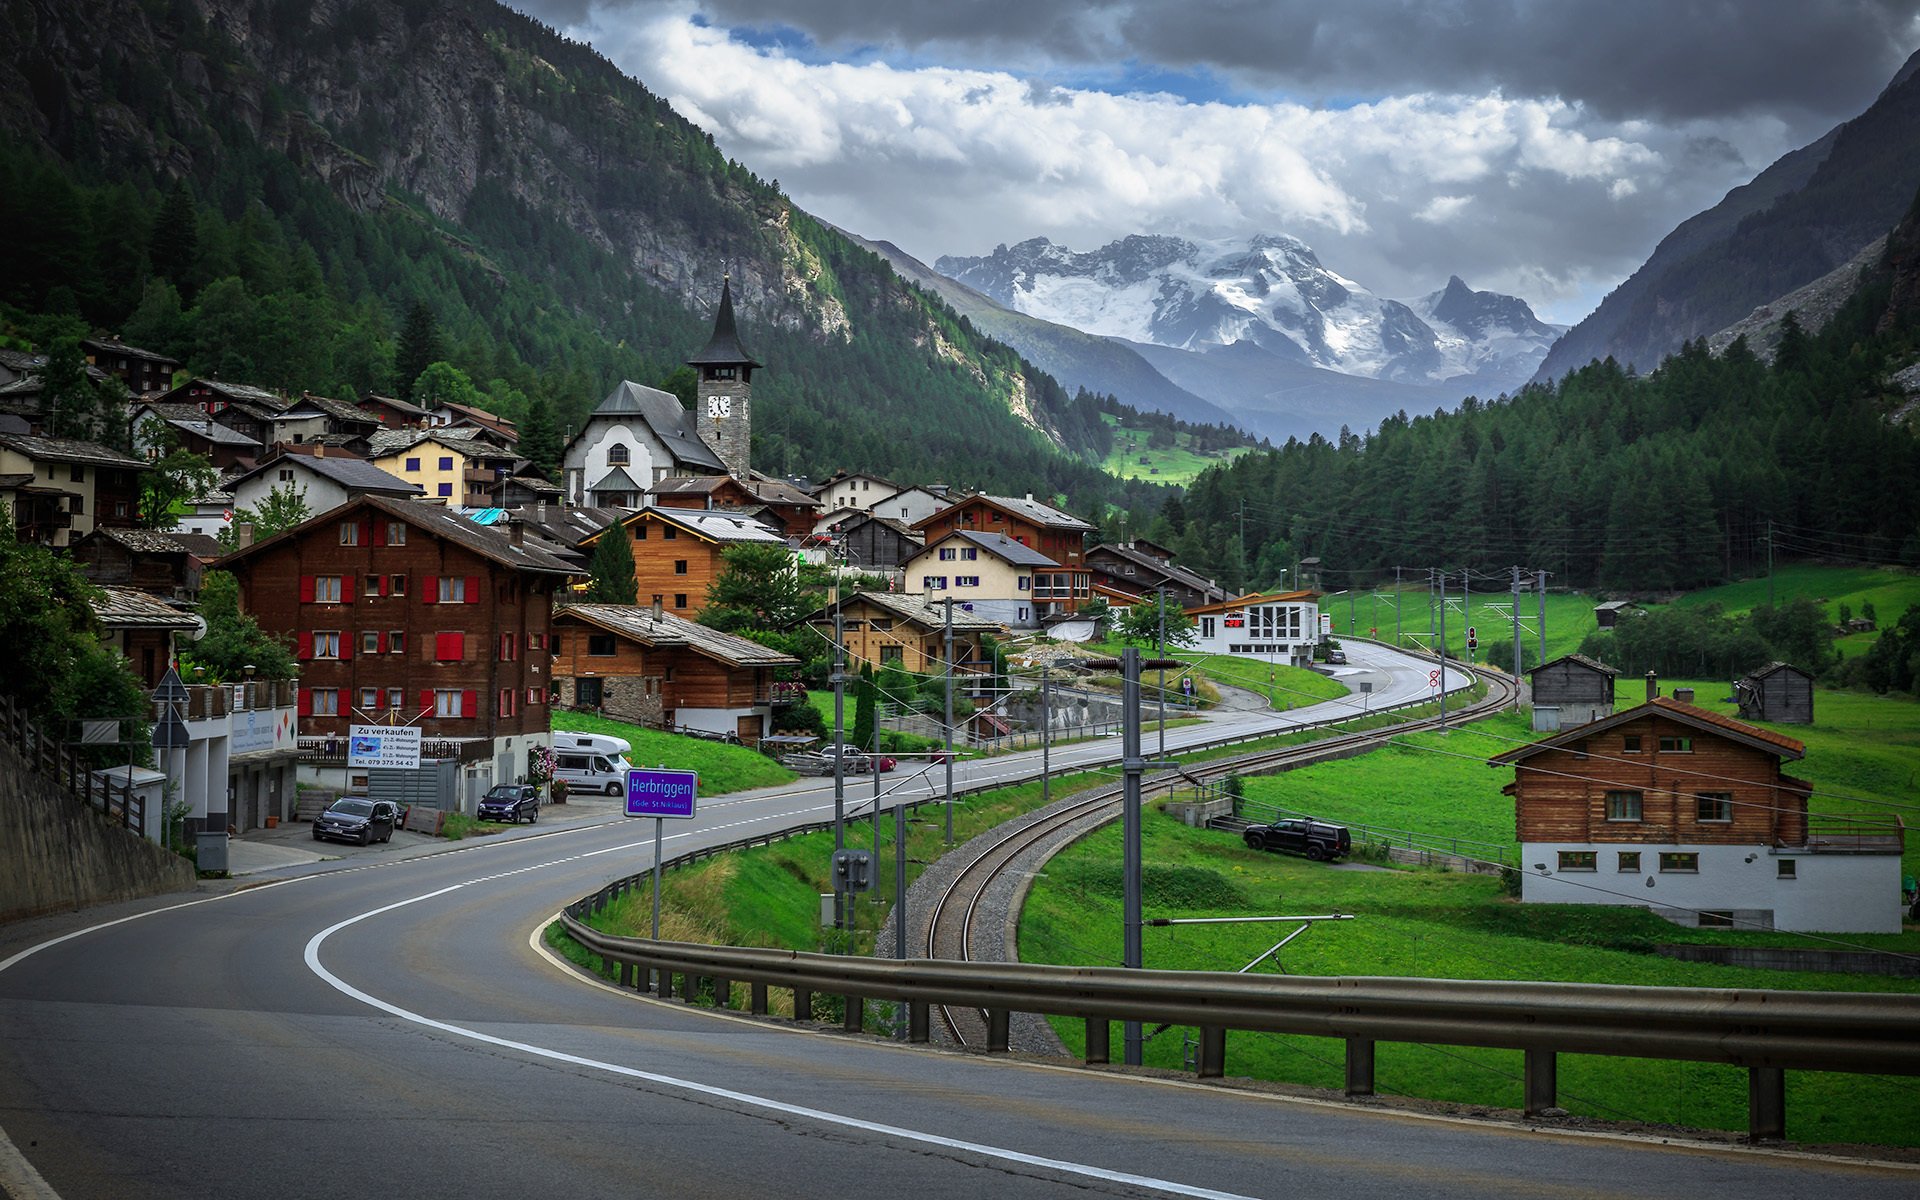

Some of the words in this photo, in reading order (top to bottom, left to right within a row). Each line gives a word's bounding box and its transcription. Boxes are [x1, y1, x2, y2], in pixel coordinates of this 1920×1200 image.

[358, 727, 369, 735] Zu
[371, 728, 414, 736] verkaufen
[631, 778, 691, 798] Herbriggen
